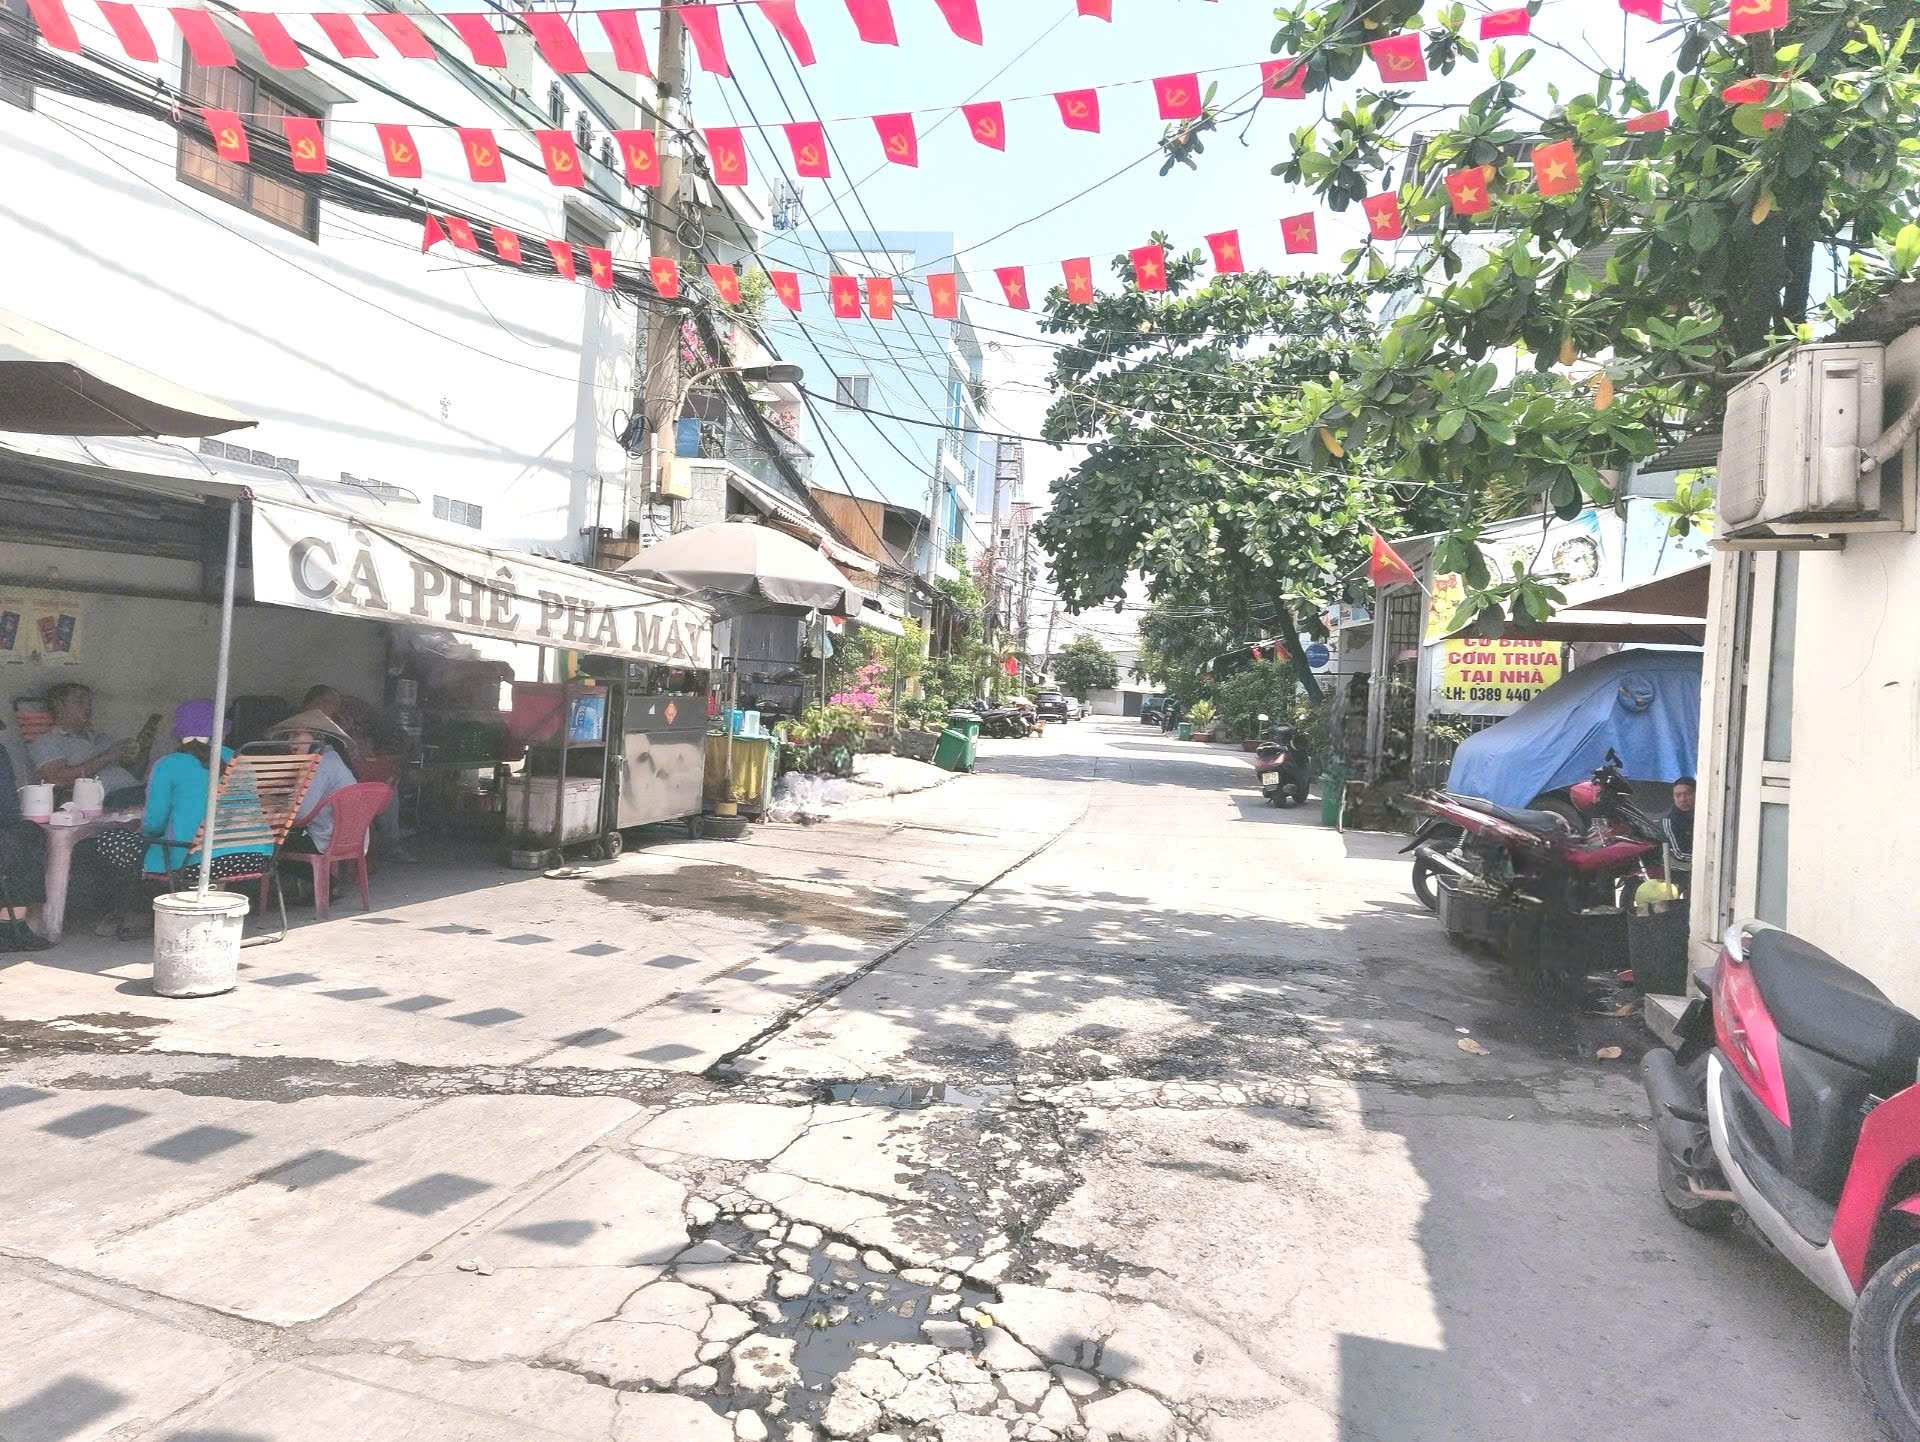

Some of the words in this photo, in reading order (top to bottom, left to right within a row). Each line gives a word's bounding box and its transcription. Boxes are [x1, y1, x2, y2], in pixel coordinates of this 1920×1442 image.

[289, 530, 390, 611] CÀ
[409, 561, 520, 632] PHÊ
[536, 589, 620, 649] PHA
[1448, 651, 1496, 665] CƠM
[1502, 651, 1558, 666] TRƯA
[1460, 669, 1493, 685] TẠI
[1499, 668, 1544, 684] NHÀ
[1470, 687, 1502, 701] 0389
[1505, 688, 1531, 702] 440
